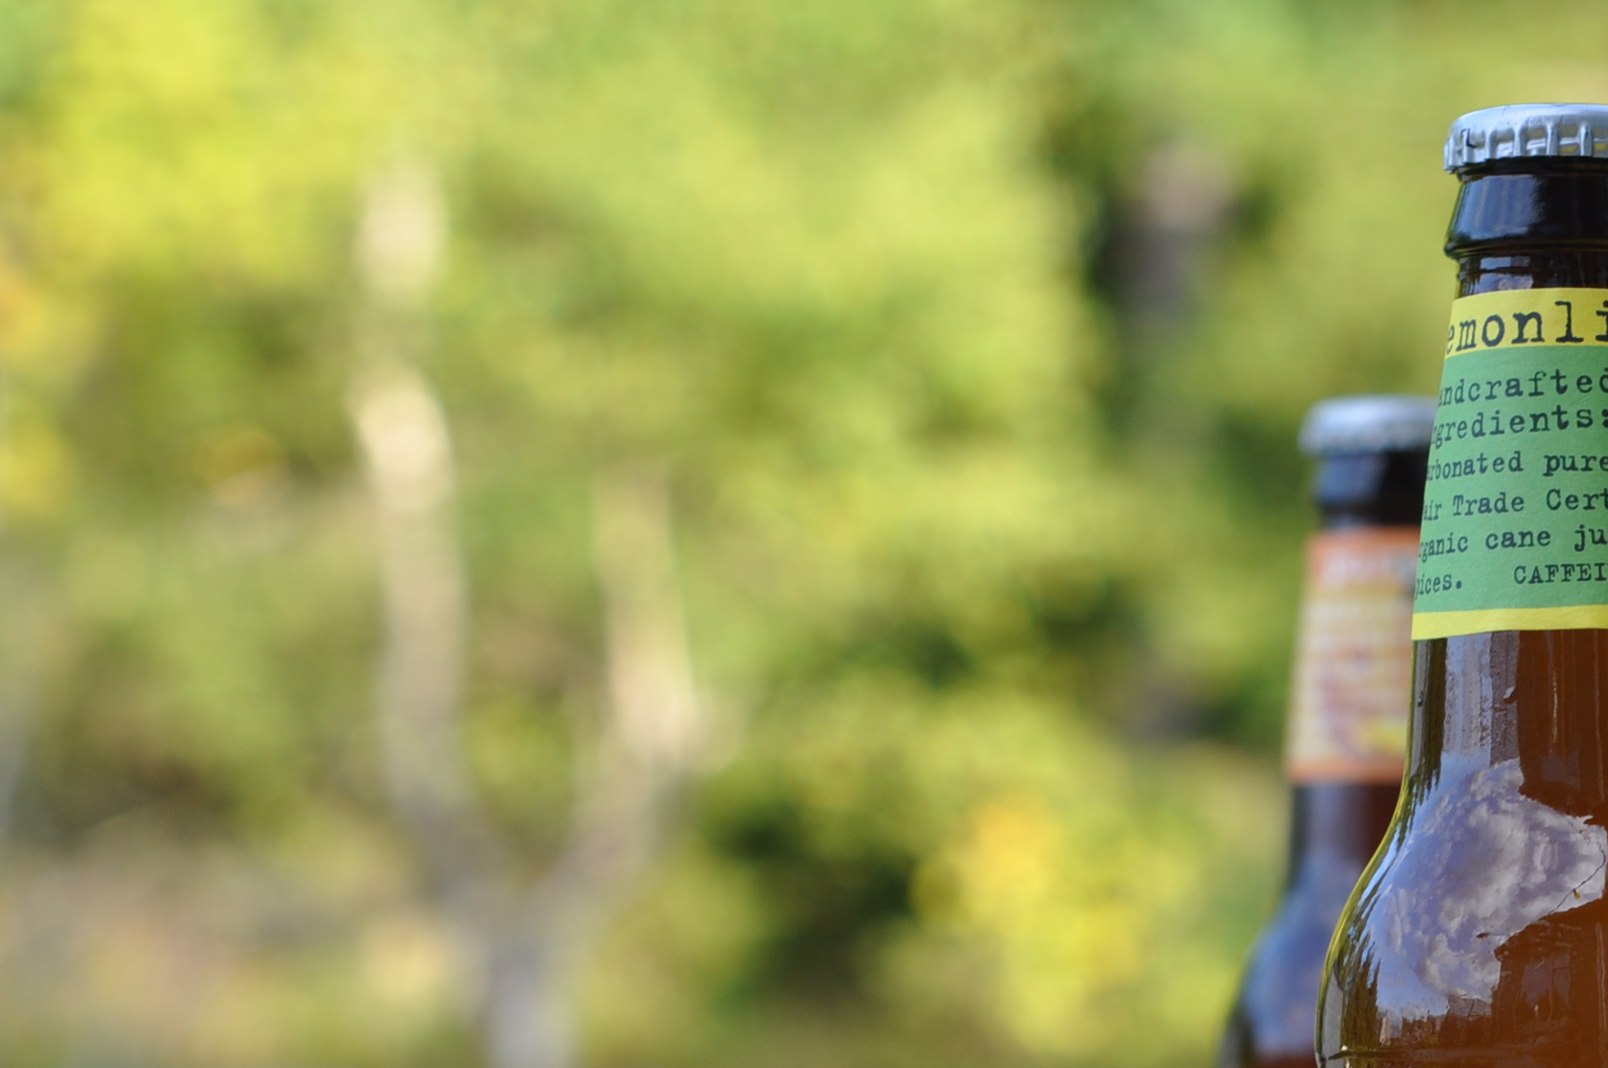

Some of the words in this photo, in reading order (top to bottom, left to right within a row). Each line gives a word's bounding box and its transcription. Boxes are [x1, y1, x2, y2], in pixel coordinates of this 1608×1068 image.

[1426, 451, 1524, 482] rbonated
[1452, 491, 1525, 517] Trade
[1485, 529, 1551, 551] cane
